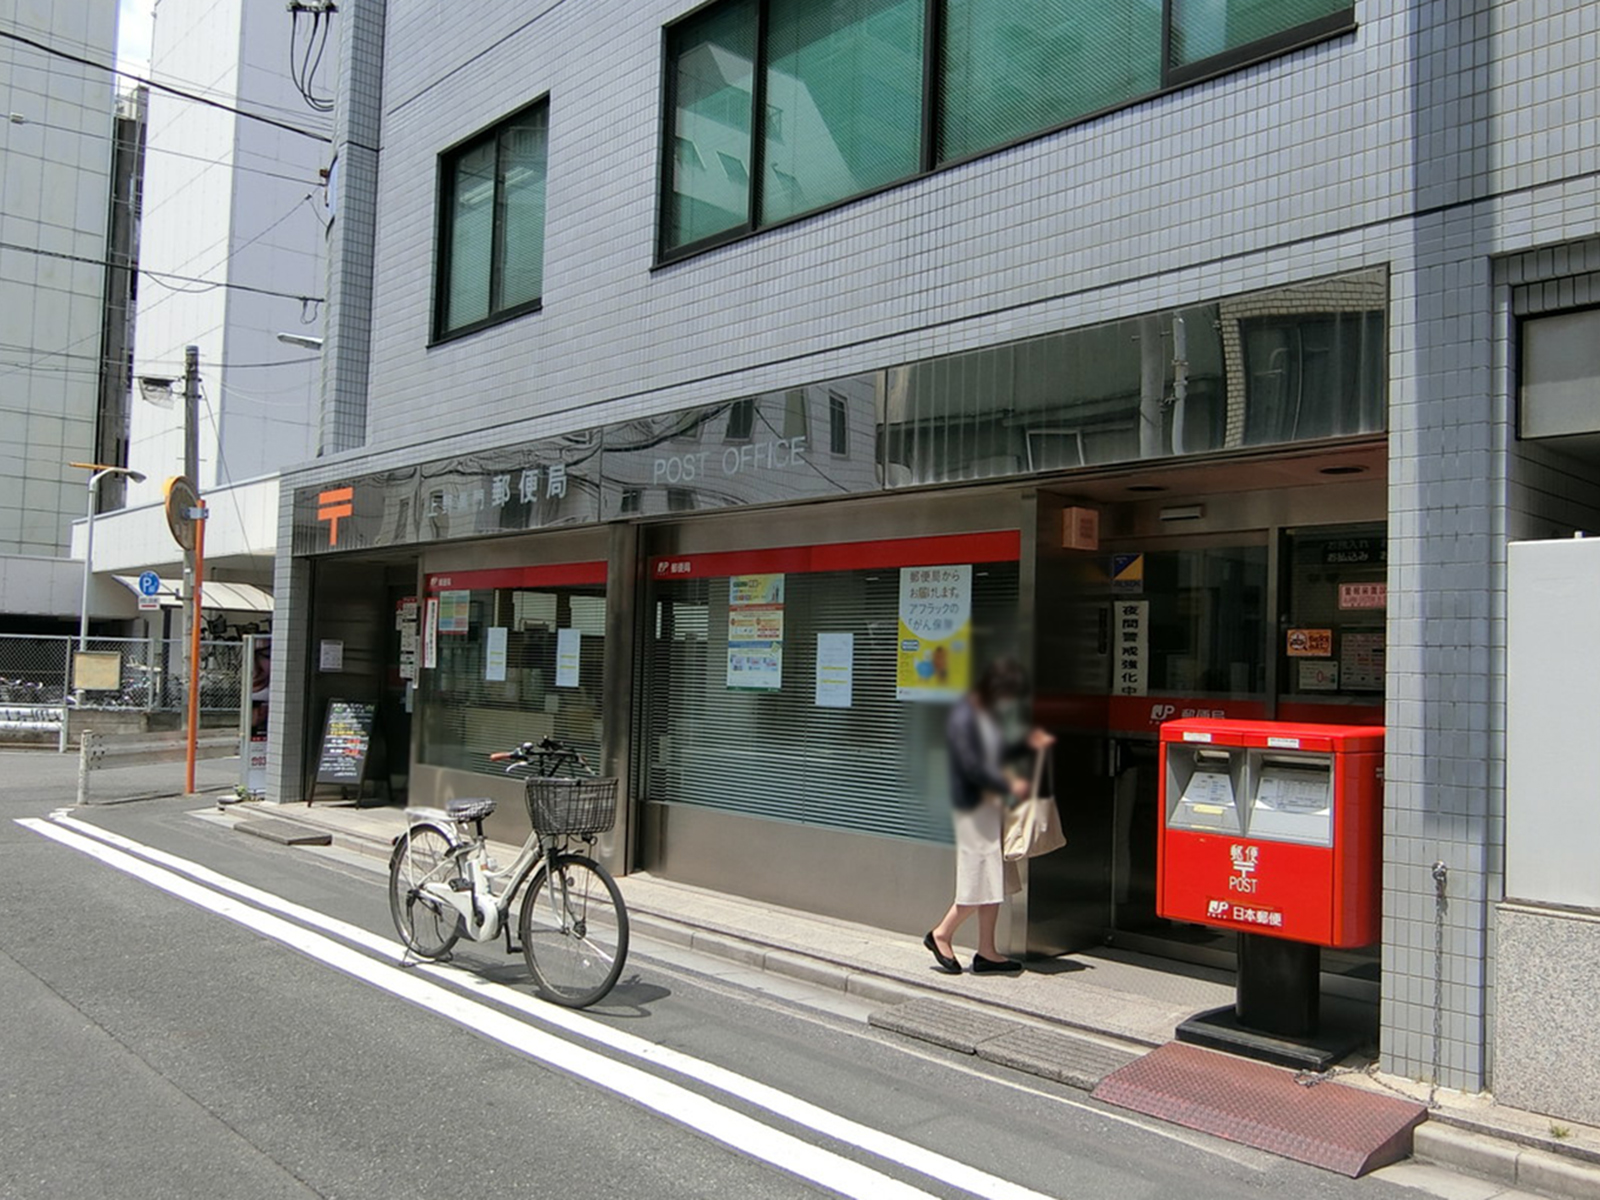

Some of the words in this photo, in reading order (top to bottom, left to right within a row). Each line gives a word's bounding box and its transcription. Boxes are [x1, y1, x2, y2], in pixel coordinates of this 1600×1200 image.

[653, 451, 710, 486] POST
[722, 436, 805, 475] OFFICE
[671, 561, 691, 574] 郵便局
[909, 570, 960, 582] 郵便局から
[909, 587, 960, 599] お届けします。
[908, 603, 959, 614] アフラックの
[1121, 605, 1140, 696] 夜間警戒強化中
[1150, 704, 1175, 720] JP
[1230, 844, 1259, 864] 郵便
[1229, 876, 1258, 893] POST
[1208, 900, 1229, 914] JP
[1233, 907, 1282, 926] 日本郵便
